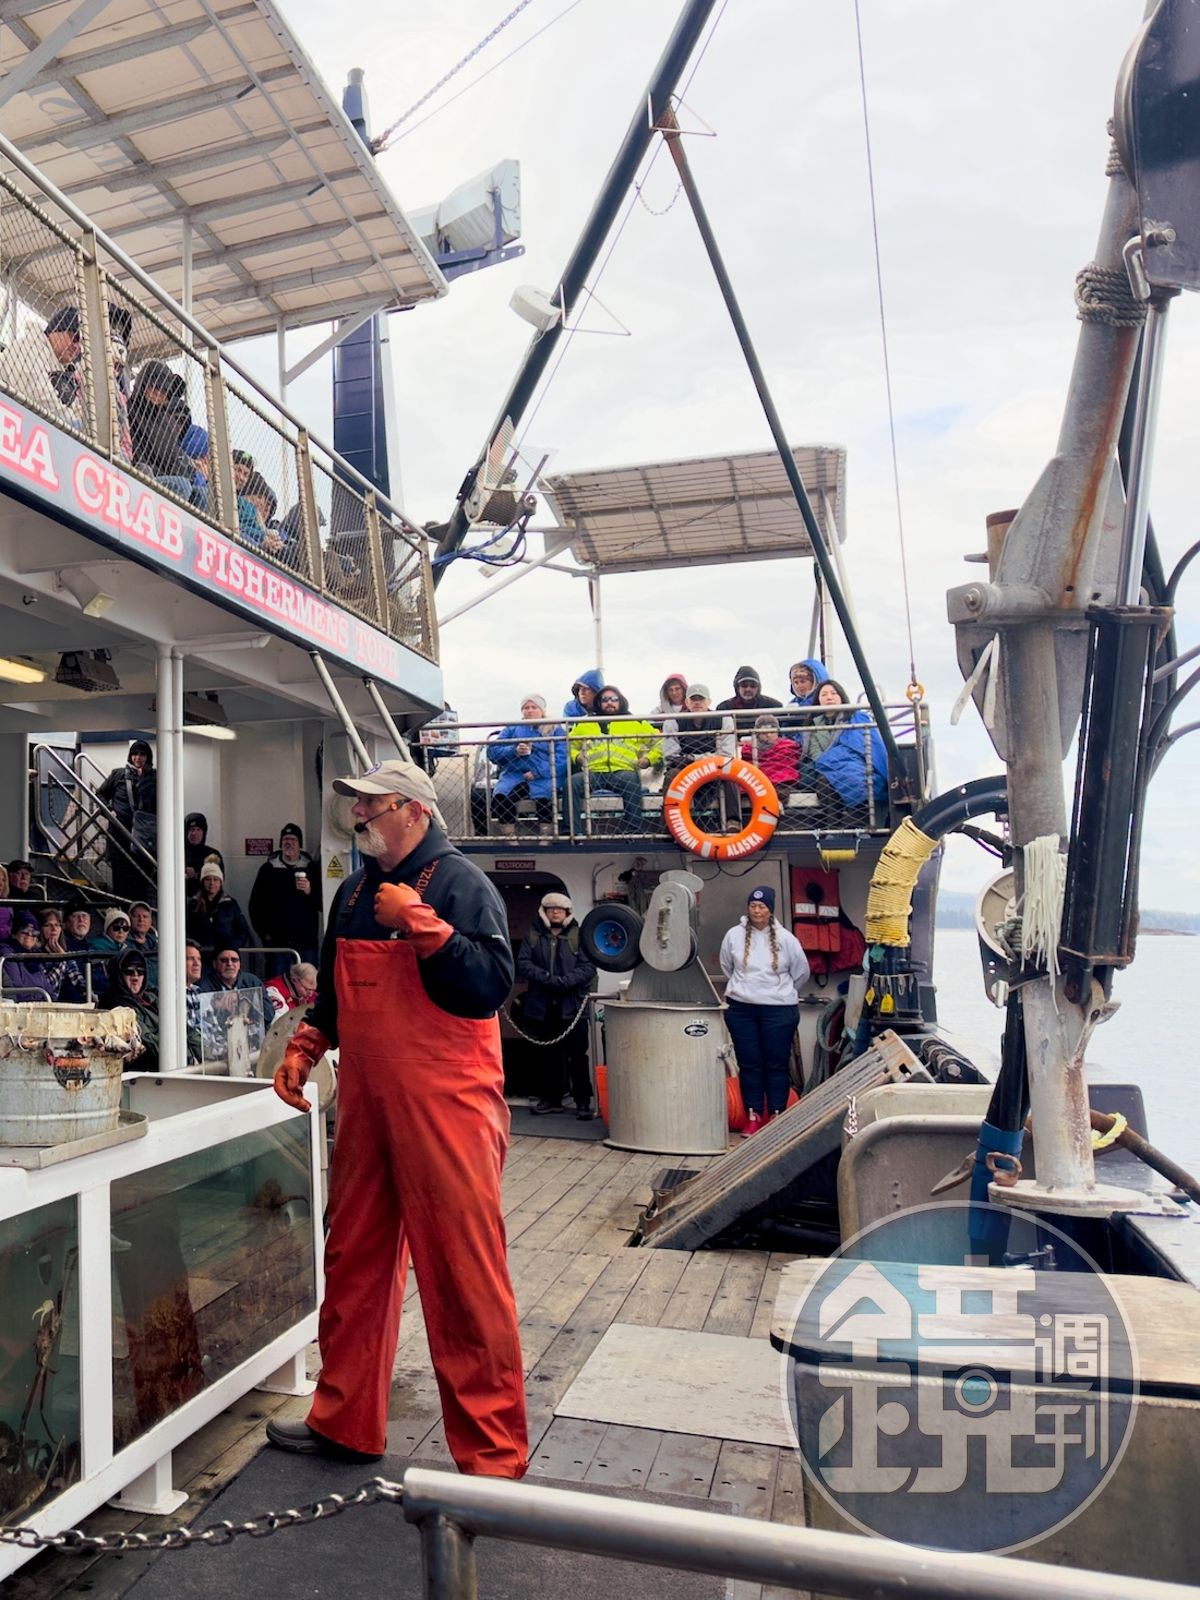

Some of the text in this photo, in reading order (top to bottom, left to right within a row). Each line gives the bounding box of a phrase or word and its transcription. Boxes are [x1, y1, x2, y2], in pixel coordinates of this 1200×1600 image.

[74, 457, 184, 558] CRAB
[197, 530, 349, 651] FISHERMENS
[676, 762, 717, 794] ALEUTIAN
[726, 832, 763, 857] ALASKA
